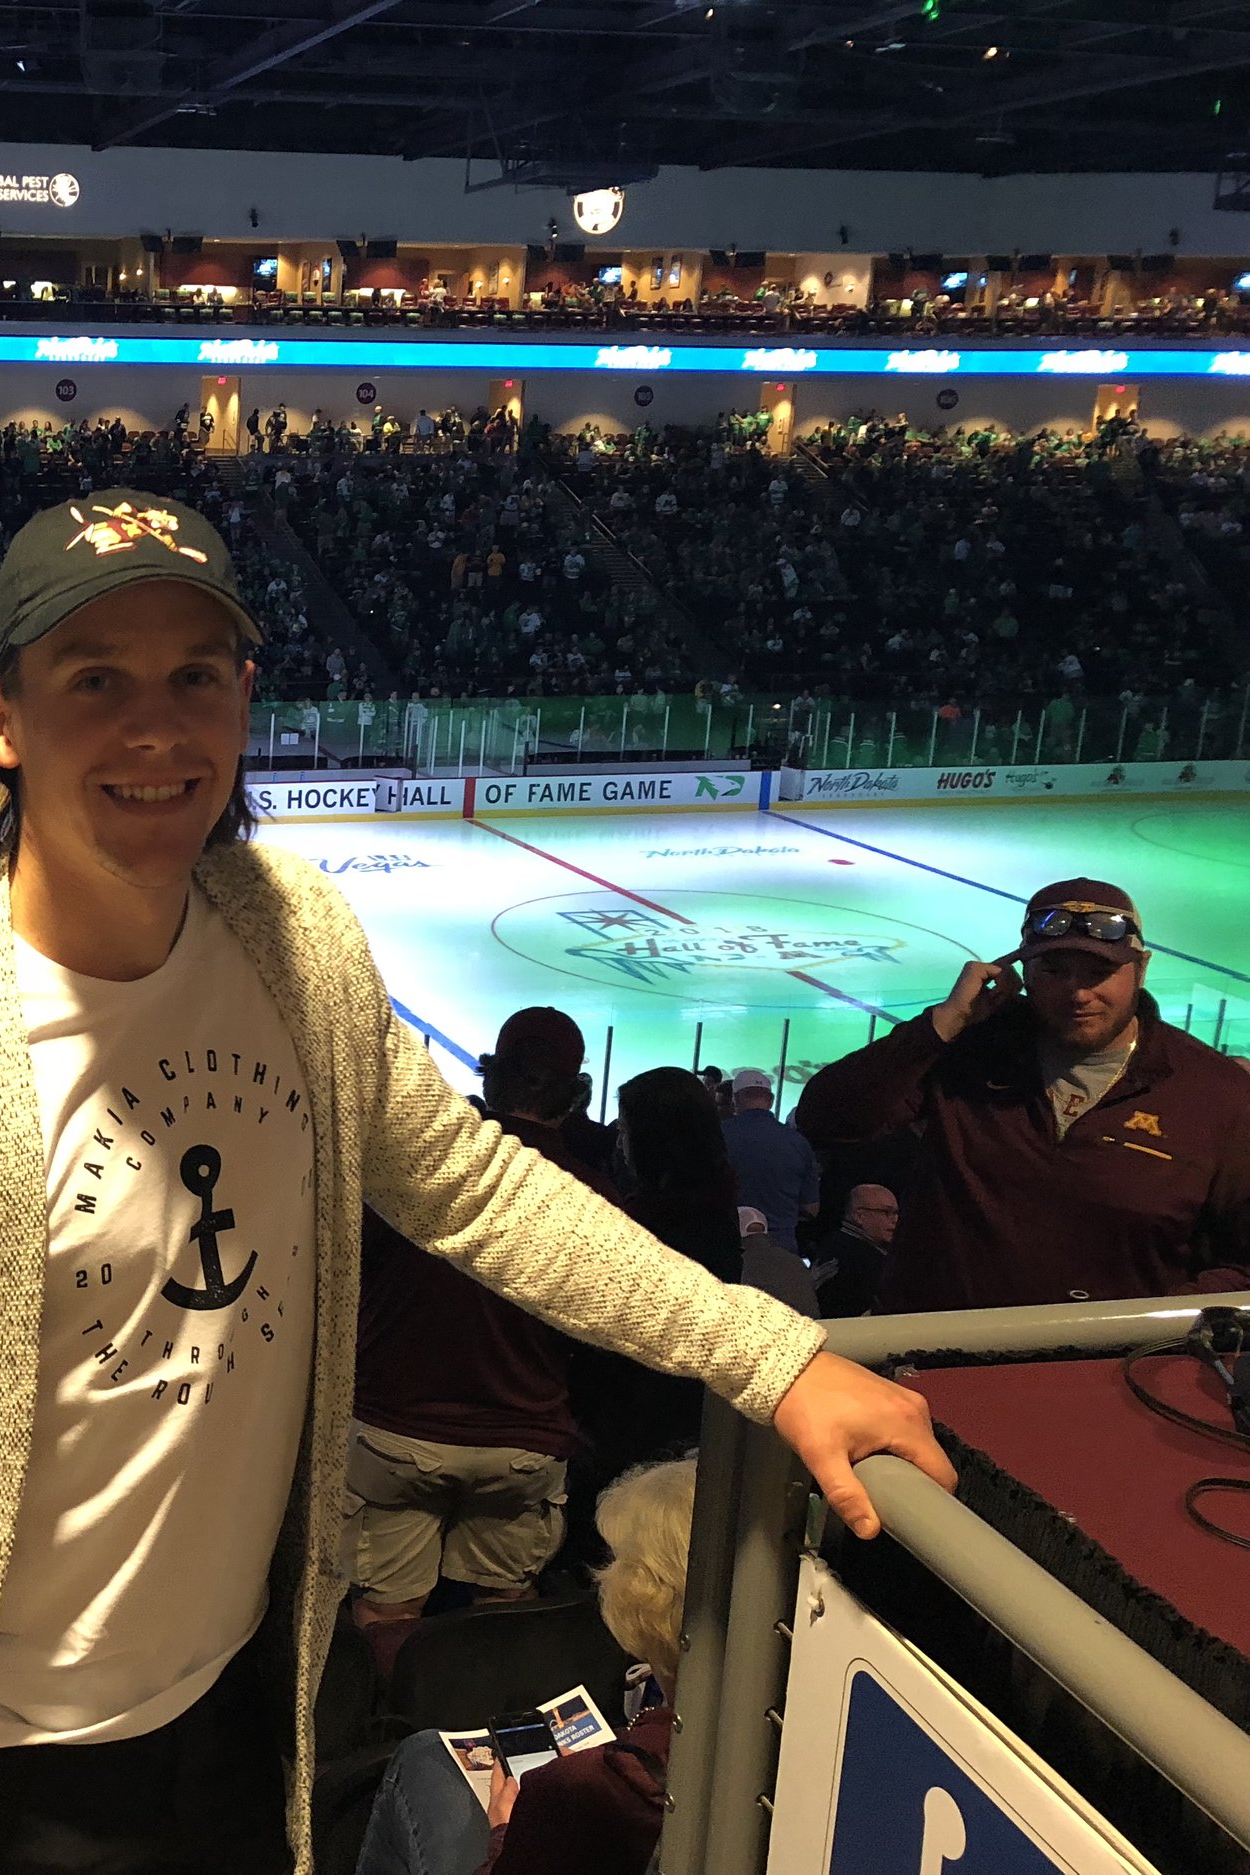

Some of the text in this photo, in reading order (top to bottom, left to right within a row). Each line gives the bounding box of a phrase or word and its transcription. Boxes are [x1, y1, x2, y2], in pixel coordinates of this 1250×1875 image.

[22, 176, 49, 188] PEST
[57, 386, 75, 395] 103
[359, 389, 374, 399] 104
[807, 773, 852, 795] North
[937, 768, 996, 789] HUGO'S
[485, 783, 517, 804] OF
[528, 782, 592, 803] FAME
[602, 780, 672, 800] GAME
[308, 856, 438, 873] Vegas
[645, 926, 768, 937] 2018
[617, 938, 707, 957] Hall
[738, 934, 862, 949] Fame
[75, 1050, 309, 1214] MAKIA CLOTHING
[126, 1092, 269, 1171] COMPANY
[76, 1263, 112, 1288] 20
[141, 1285, 270, 1364] THROGH
[82, 1319, 129, 1382] THE
[151, 1351, 235, 1405] ROUH
[554, 1725, 577, 1740] DAKOTA
[571, 1724, 595, 1740] ROSTER
